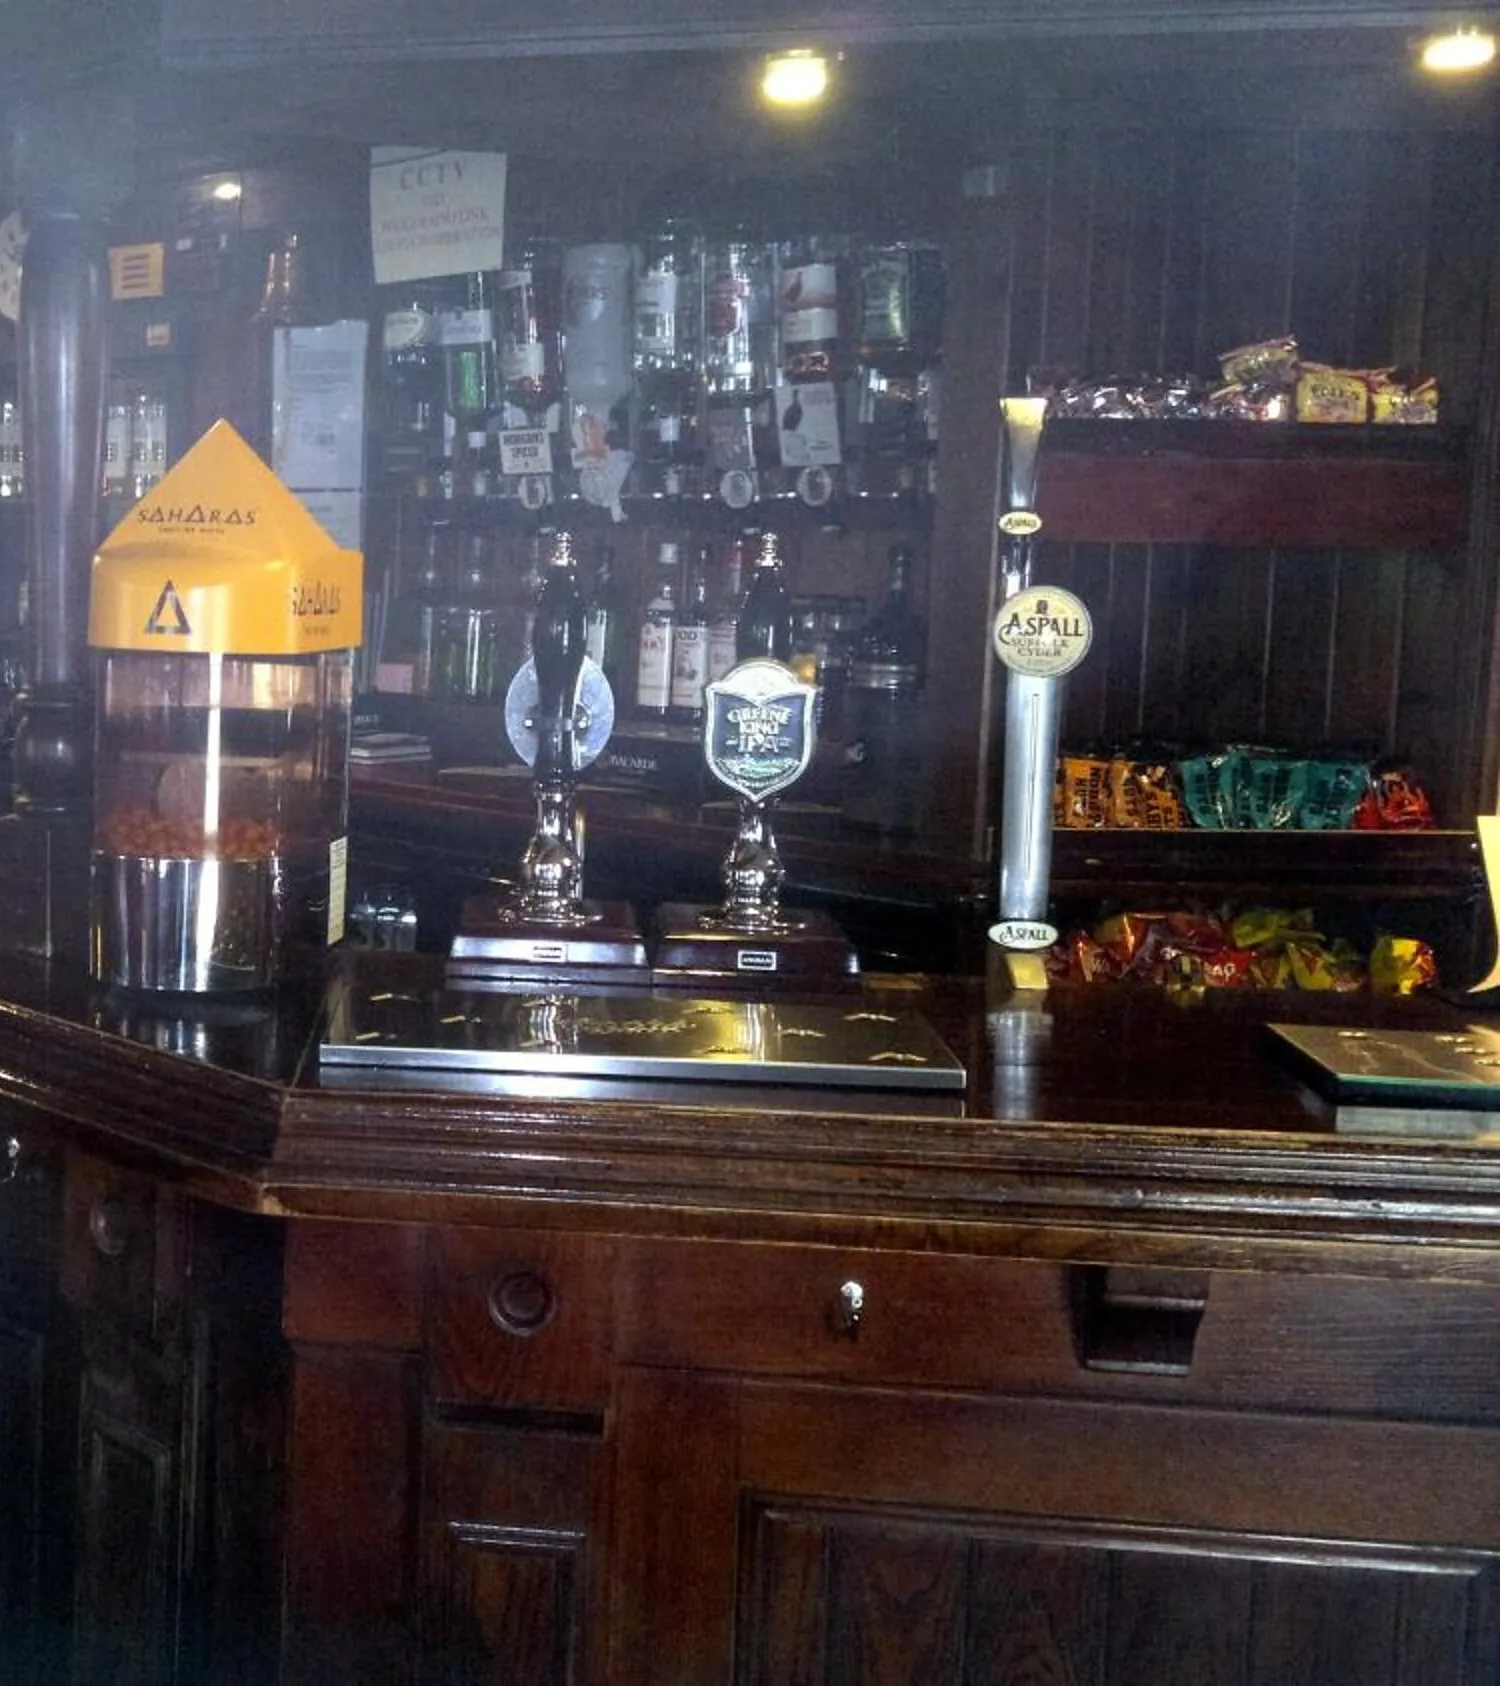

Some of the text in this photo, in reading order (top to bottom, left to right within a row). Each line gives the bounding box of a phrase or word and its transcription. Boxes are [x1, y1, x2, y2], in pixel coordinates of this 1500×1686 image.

[400, 156, 468, 190] CCTV
[138, 504, 257, 526] SAHARAS
[998, 612, 1084, 645] ASPALL
[727, 705, 792, 724] GREENE
[739, 719, 779, 735] KING
[738, 733, 779, 753] IPA
[1000, 925, 1048, 942] ASPALL
